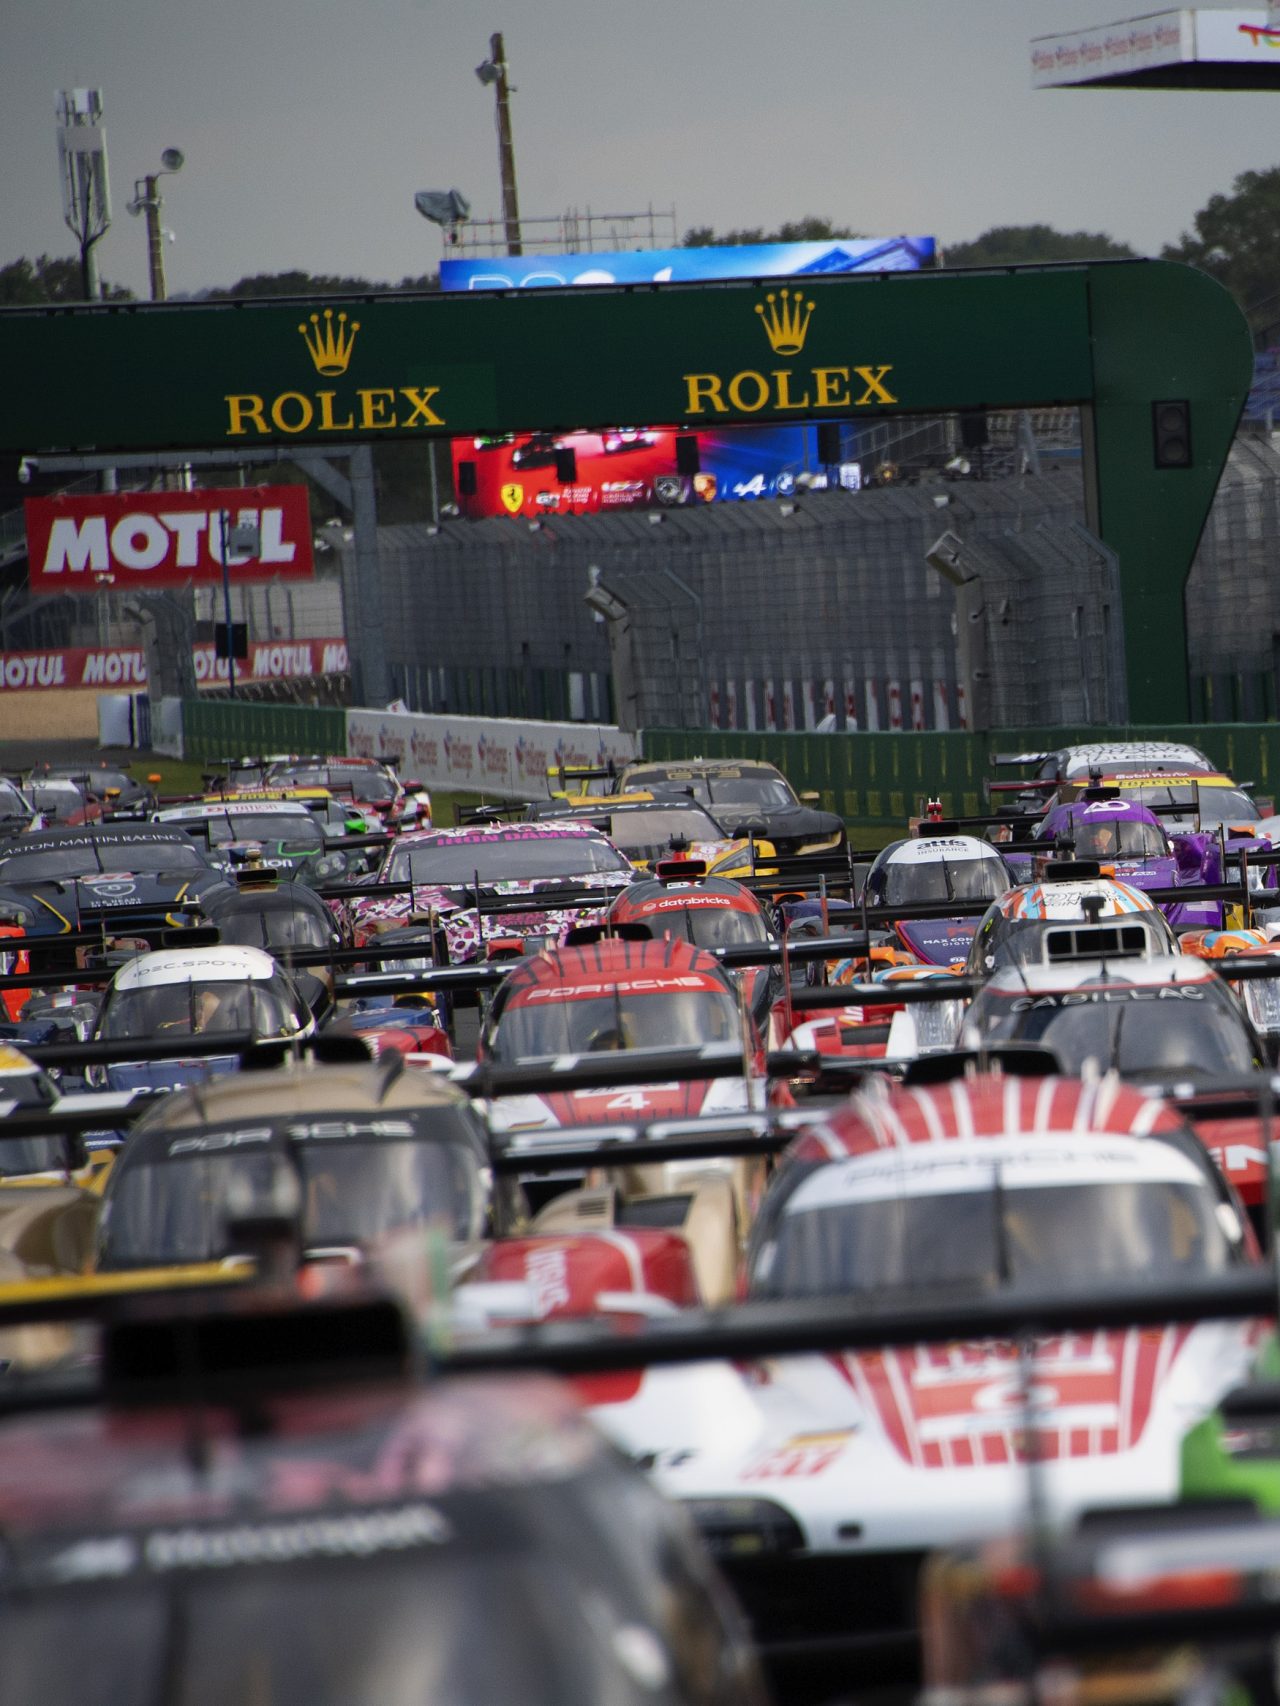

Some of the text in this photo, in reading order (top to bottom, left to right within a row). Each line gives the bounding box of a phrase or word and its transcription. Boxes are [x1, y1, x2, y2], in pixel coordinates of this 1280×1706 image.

[683, 365, 898, 414] ROLEX
[225, 386, 446, 434] ROLEX
[43, 508, 296, 573] MOTUL
[0, 655, 64, 686] OTUL
[82, 652, 146, 684] MOTU
[253, 646, 313, 677] MOTUL
[3, 833, 182, 855] ASTON MARTIN RACING
[437, 830, 589, 846] IRON DAMES
[659, 896, 730, 908] databricks
[527, 976, 706, 1000] PORSCHE
[1011, 986, 1204, 1012] CADILLAC
[606, 1092, 650, 1110] 4
